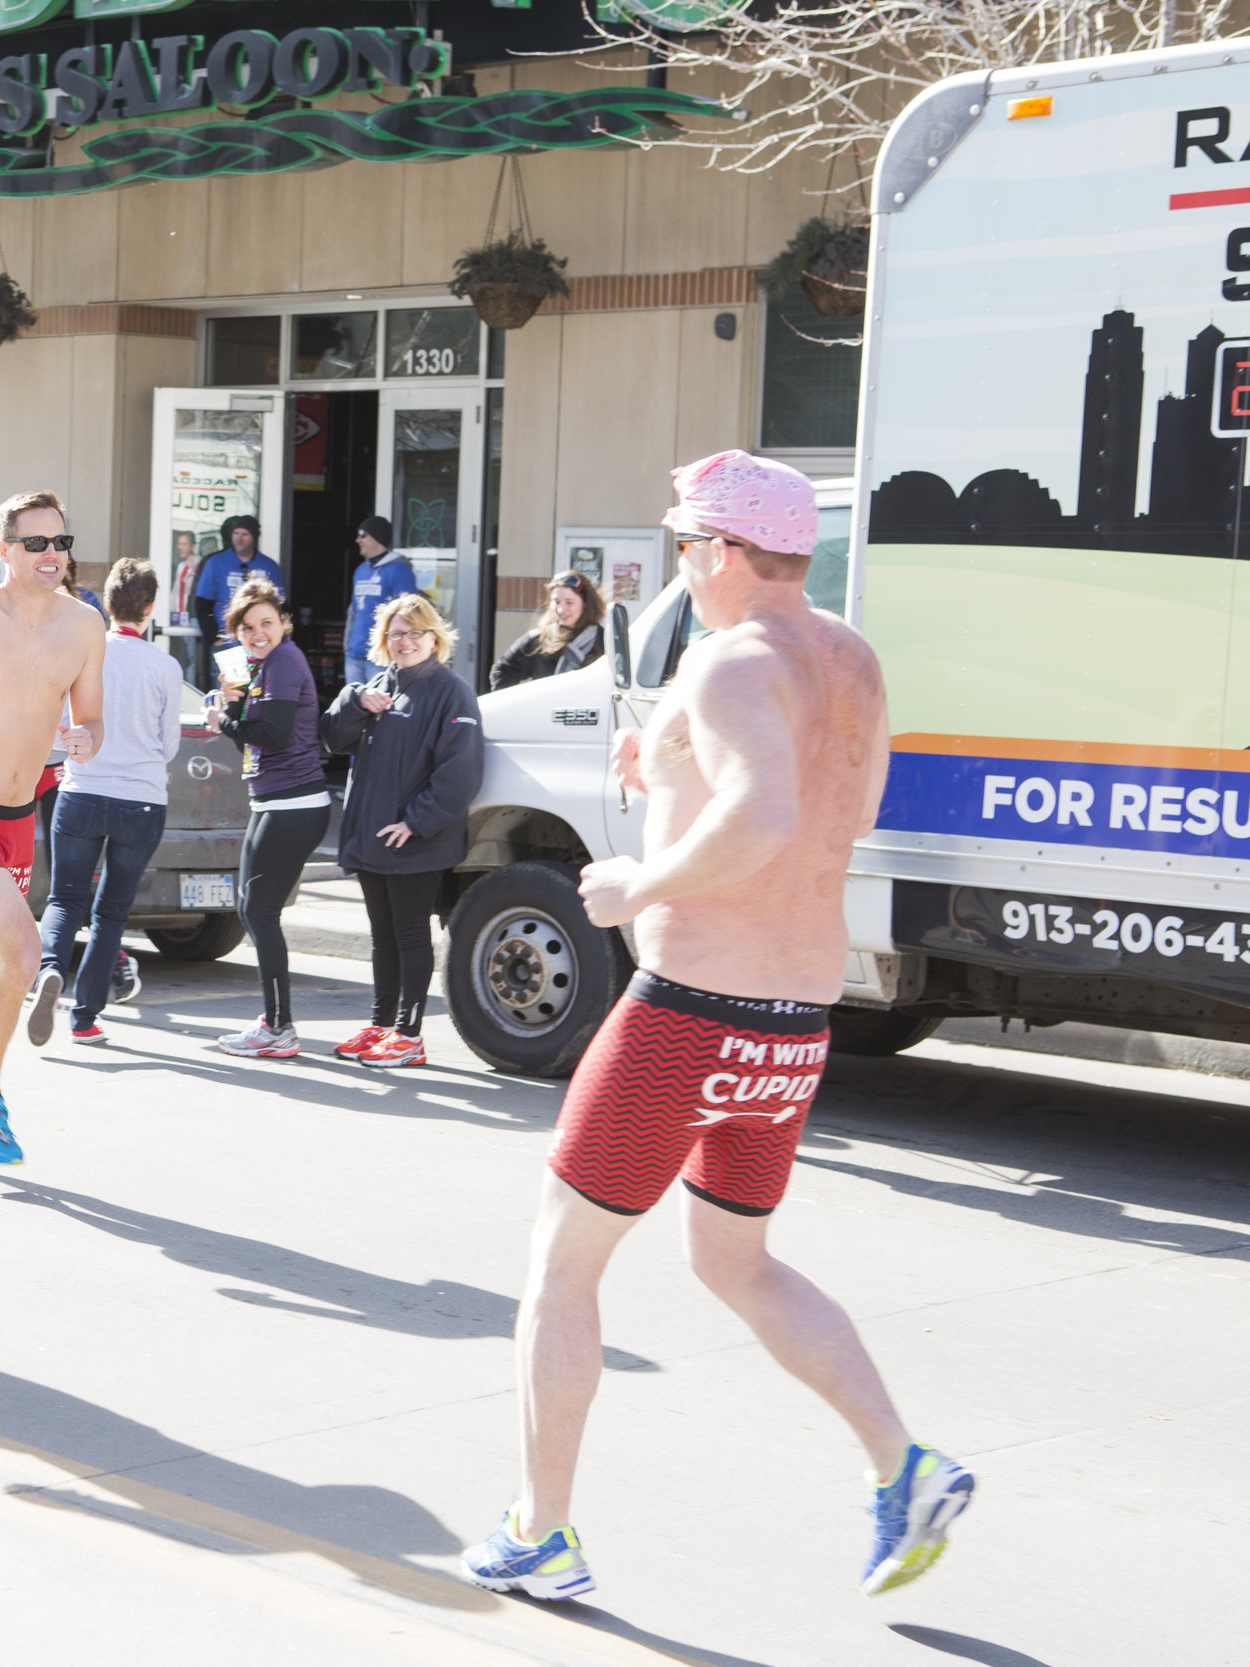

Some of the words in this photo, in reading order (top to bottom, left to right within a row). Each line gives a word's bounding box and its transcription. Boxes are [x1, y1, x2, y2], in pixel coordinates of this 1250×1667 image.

[53, 27, 426, 132] SALOON
[403, 347, 454, 375] 1330
[552, 709, 599, 722] E350
[982, 775, 1095, 827] FOR
[1109, 783, 1250, 839] RESU
[718, 1035, 768, 1066] I'M
[773, 1039, 828, 1066] WITH
[701, 1072, 820, 1104] CUPID
